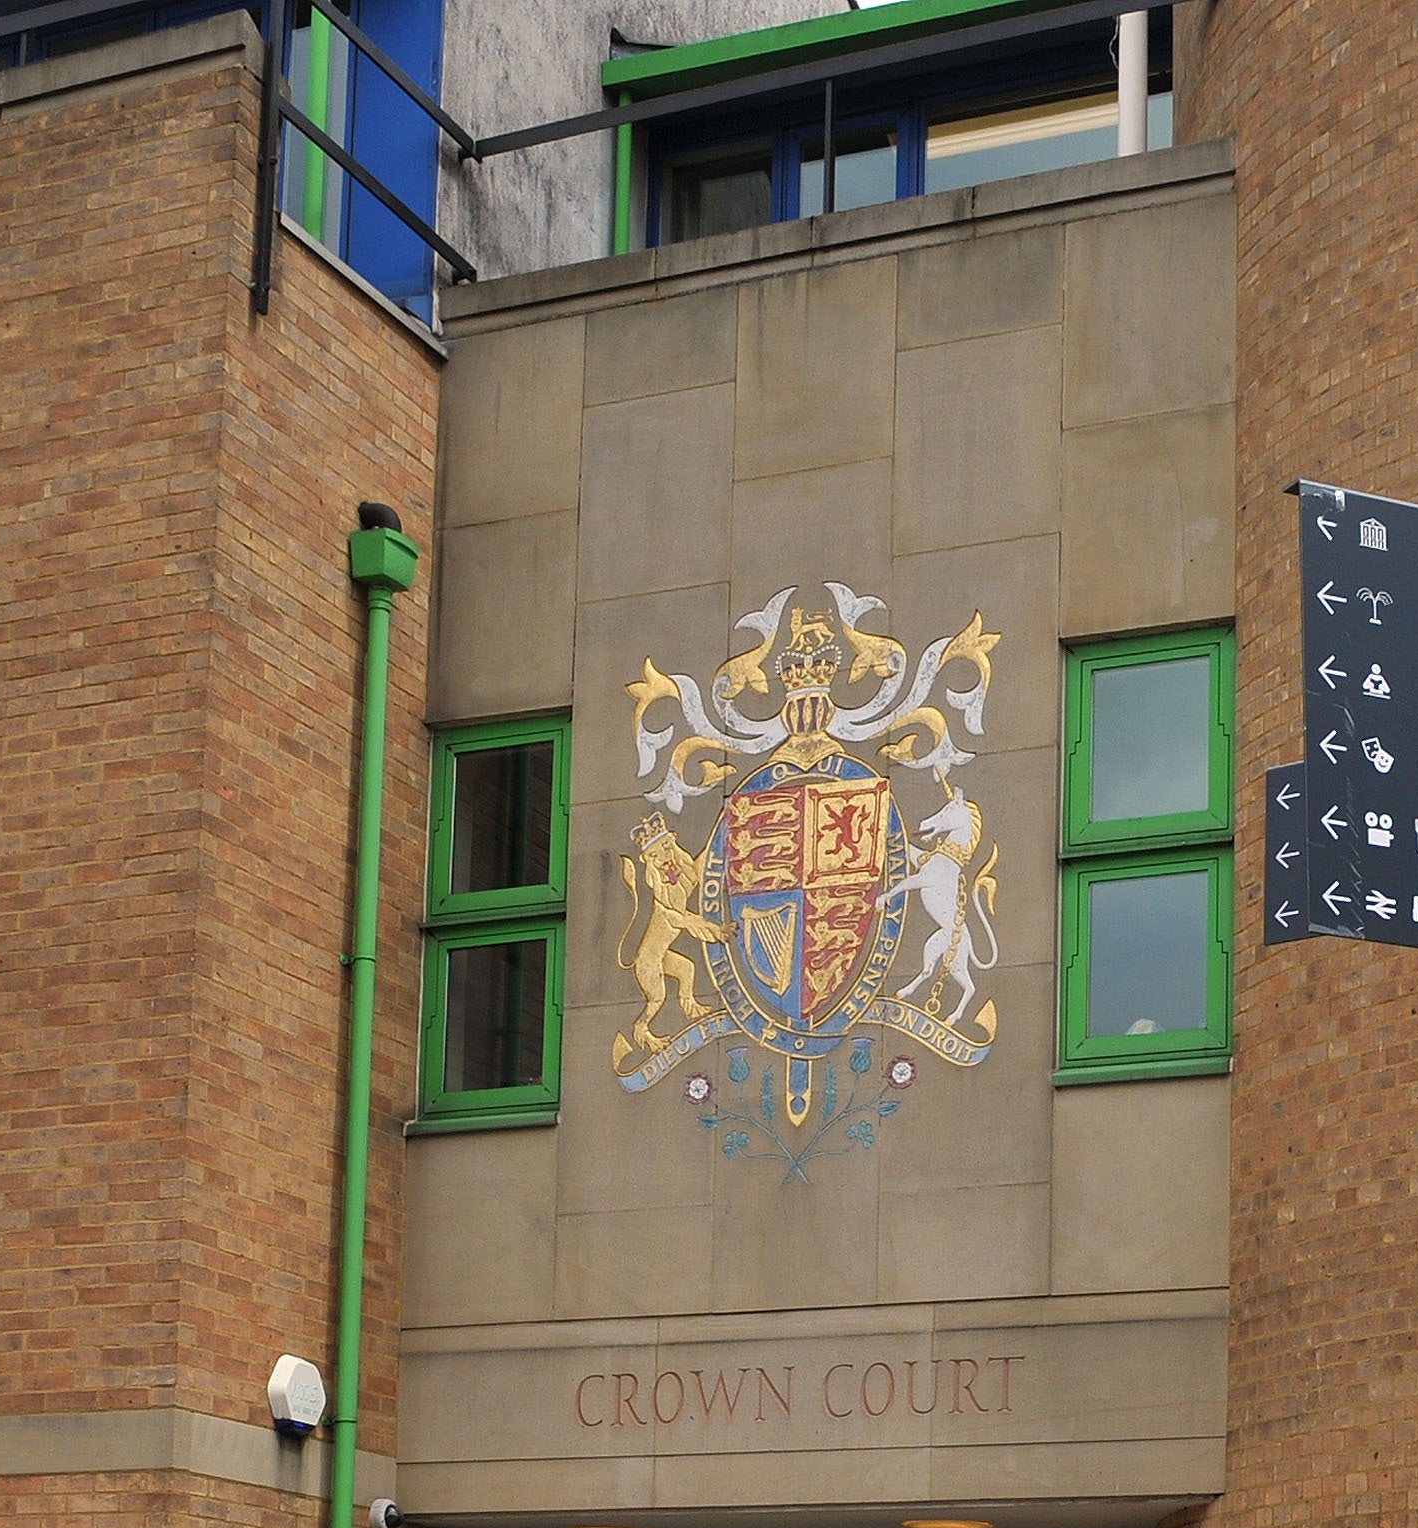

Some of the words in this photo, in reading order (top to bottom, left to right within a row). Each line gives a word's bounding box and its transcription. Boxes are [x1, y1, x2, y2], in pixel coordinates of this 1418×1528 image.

[918, 1020, 976, 1063] DROIT
[576, 1366, 795, 1428] CROWN
[823, 1356, 1025, 1420] COURT
